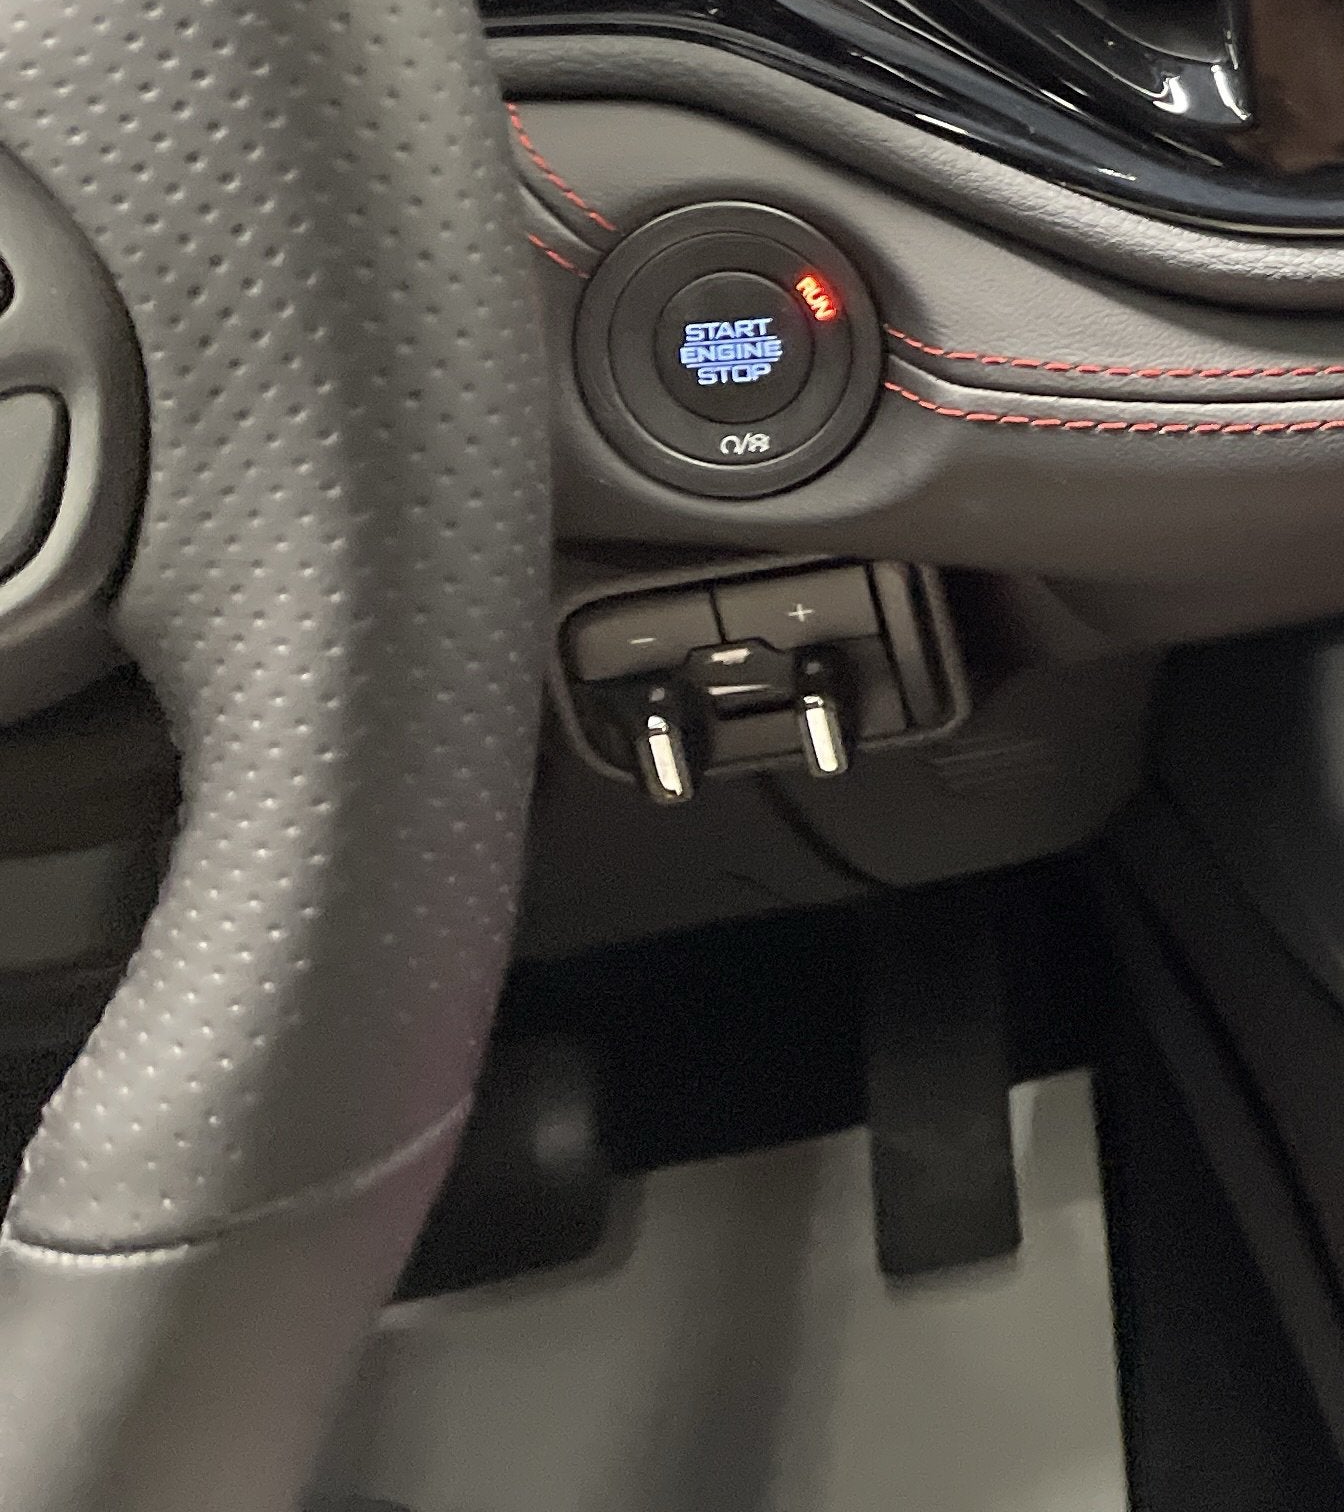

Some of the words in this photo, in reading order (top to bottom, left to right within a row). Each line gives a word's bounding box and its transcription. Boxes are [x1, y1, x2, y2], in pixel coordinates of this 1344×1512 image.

[796, 276, 836, 321] RUN
[685, 318, 773, 339] START
[680, 339, 783, 363] ENGINE
[697, 362, 772, 385] STOP
